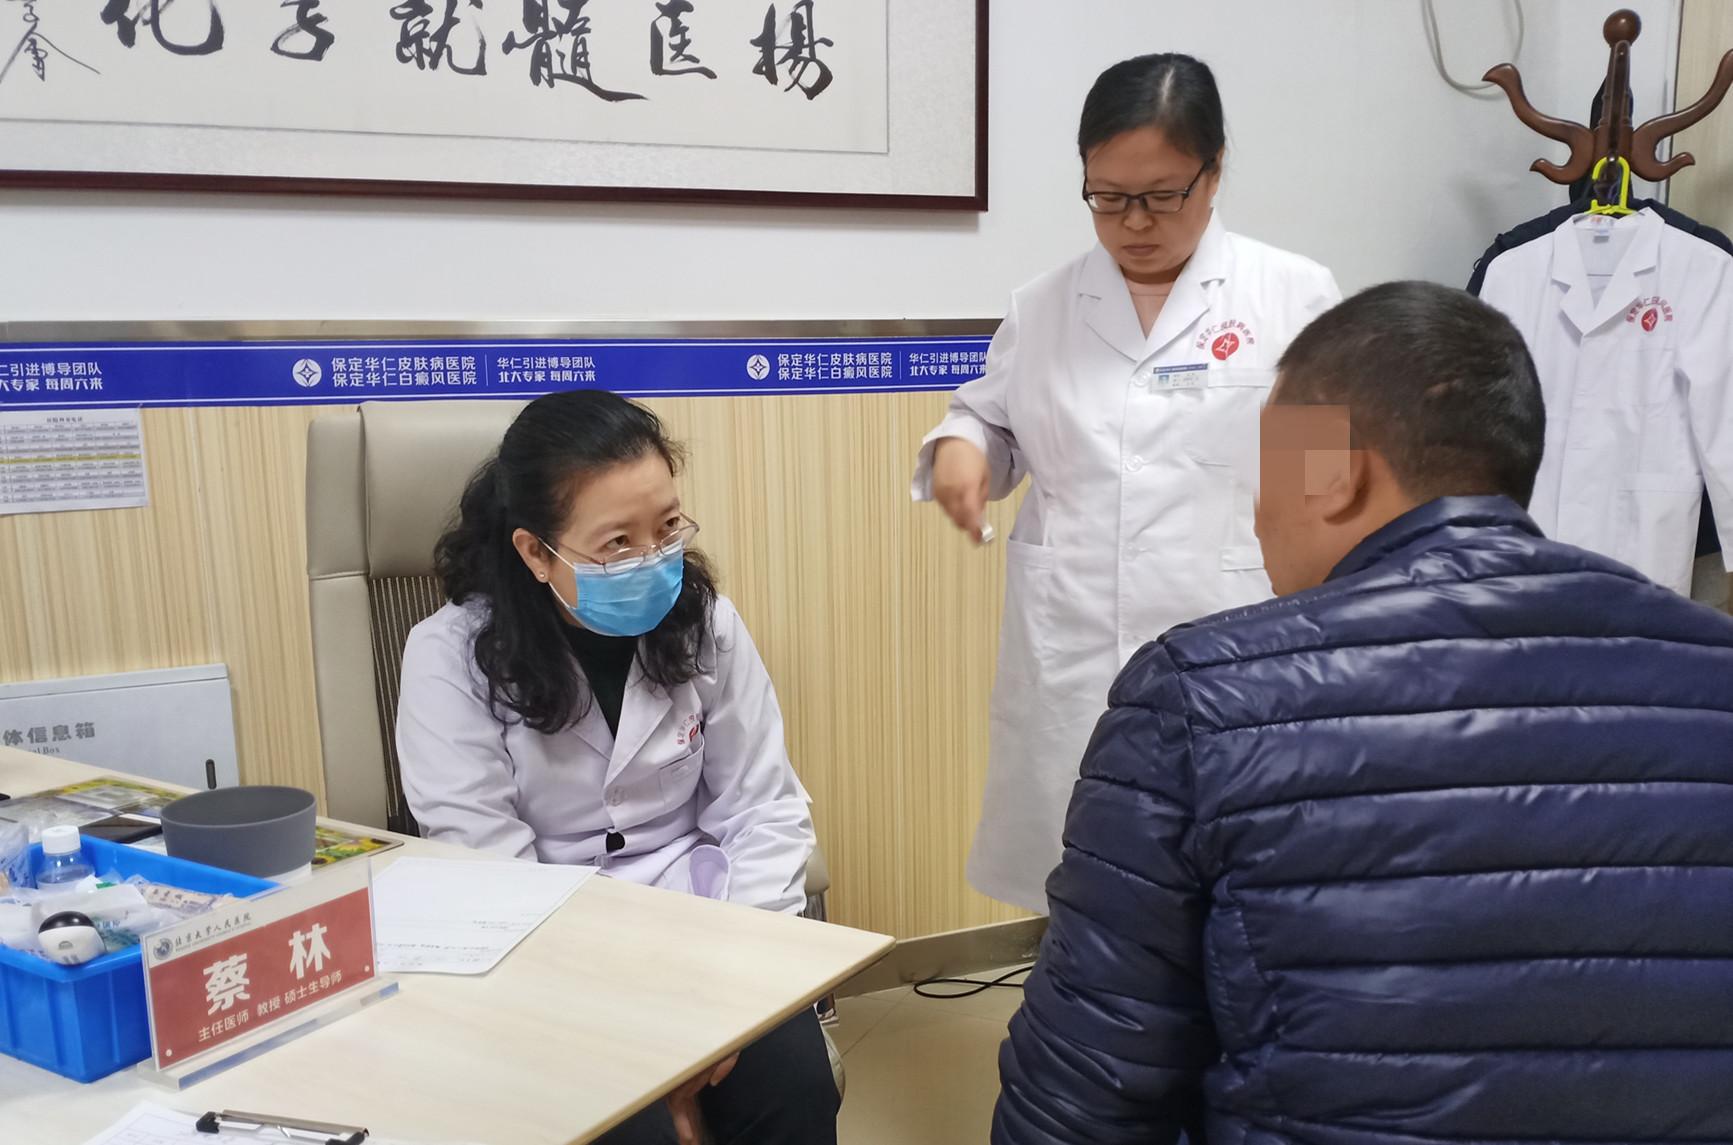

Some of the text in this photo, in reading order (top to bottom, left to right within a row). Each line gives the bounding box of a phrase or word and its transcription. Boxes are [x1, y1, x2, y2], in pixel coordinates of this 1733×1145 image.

[332, 356, 476, 372] 保定华仁皮肤病医院
[497, 357, 595, 371] 华仁引进博导团队
[778, 352, 892, 367] 保定华仁皮肤病医院
[499, 370, 595, 383] 北大专家 每周六来
[778, 366, 892, 380] 保定华仁白癜风医院
[910, 365, 947, 376] 北大专家
[46, 377, 102, 390] 每周六来
[333, 371, 477, 387] 保定华仁白癜风医院
[3, 722, 95, 746] 体信息箱
[198, 970, 342, 1042] 主任医师 教授 硕士生导师
